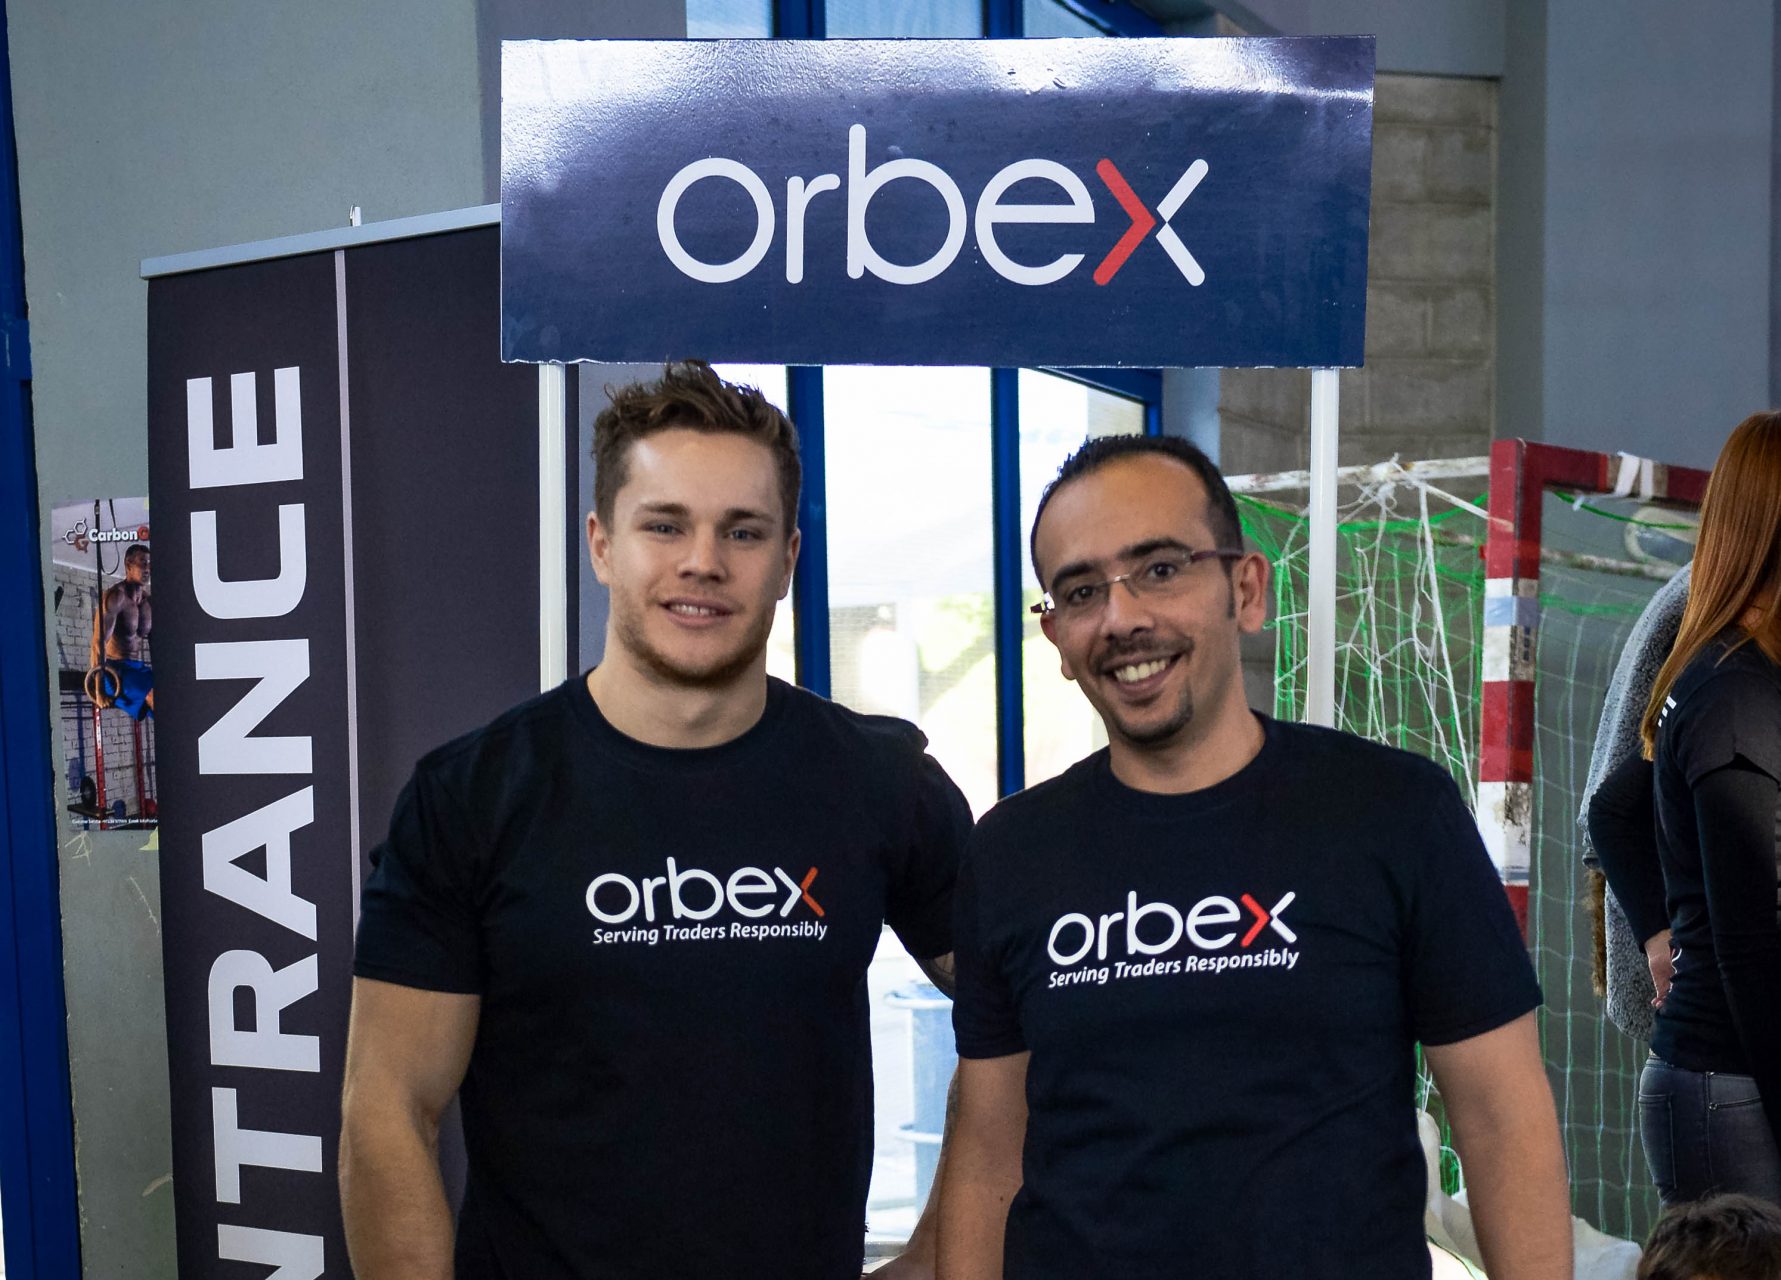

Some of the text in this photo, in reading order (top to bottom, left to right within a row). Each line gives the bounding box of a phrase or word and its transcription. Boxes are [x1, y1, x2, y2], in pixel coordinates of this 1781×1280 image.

[656, 123, 1209, 287] orbex
[586, 857, 825, 923] orbex
[592, 921, 828, 945] Serving Traders Responsibly
[1047, 890, 1297, 966] orbex
[1048, 948, 1300, 988] Serving Traders Responsibly
